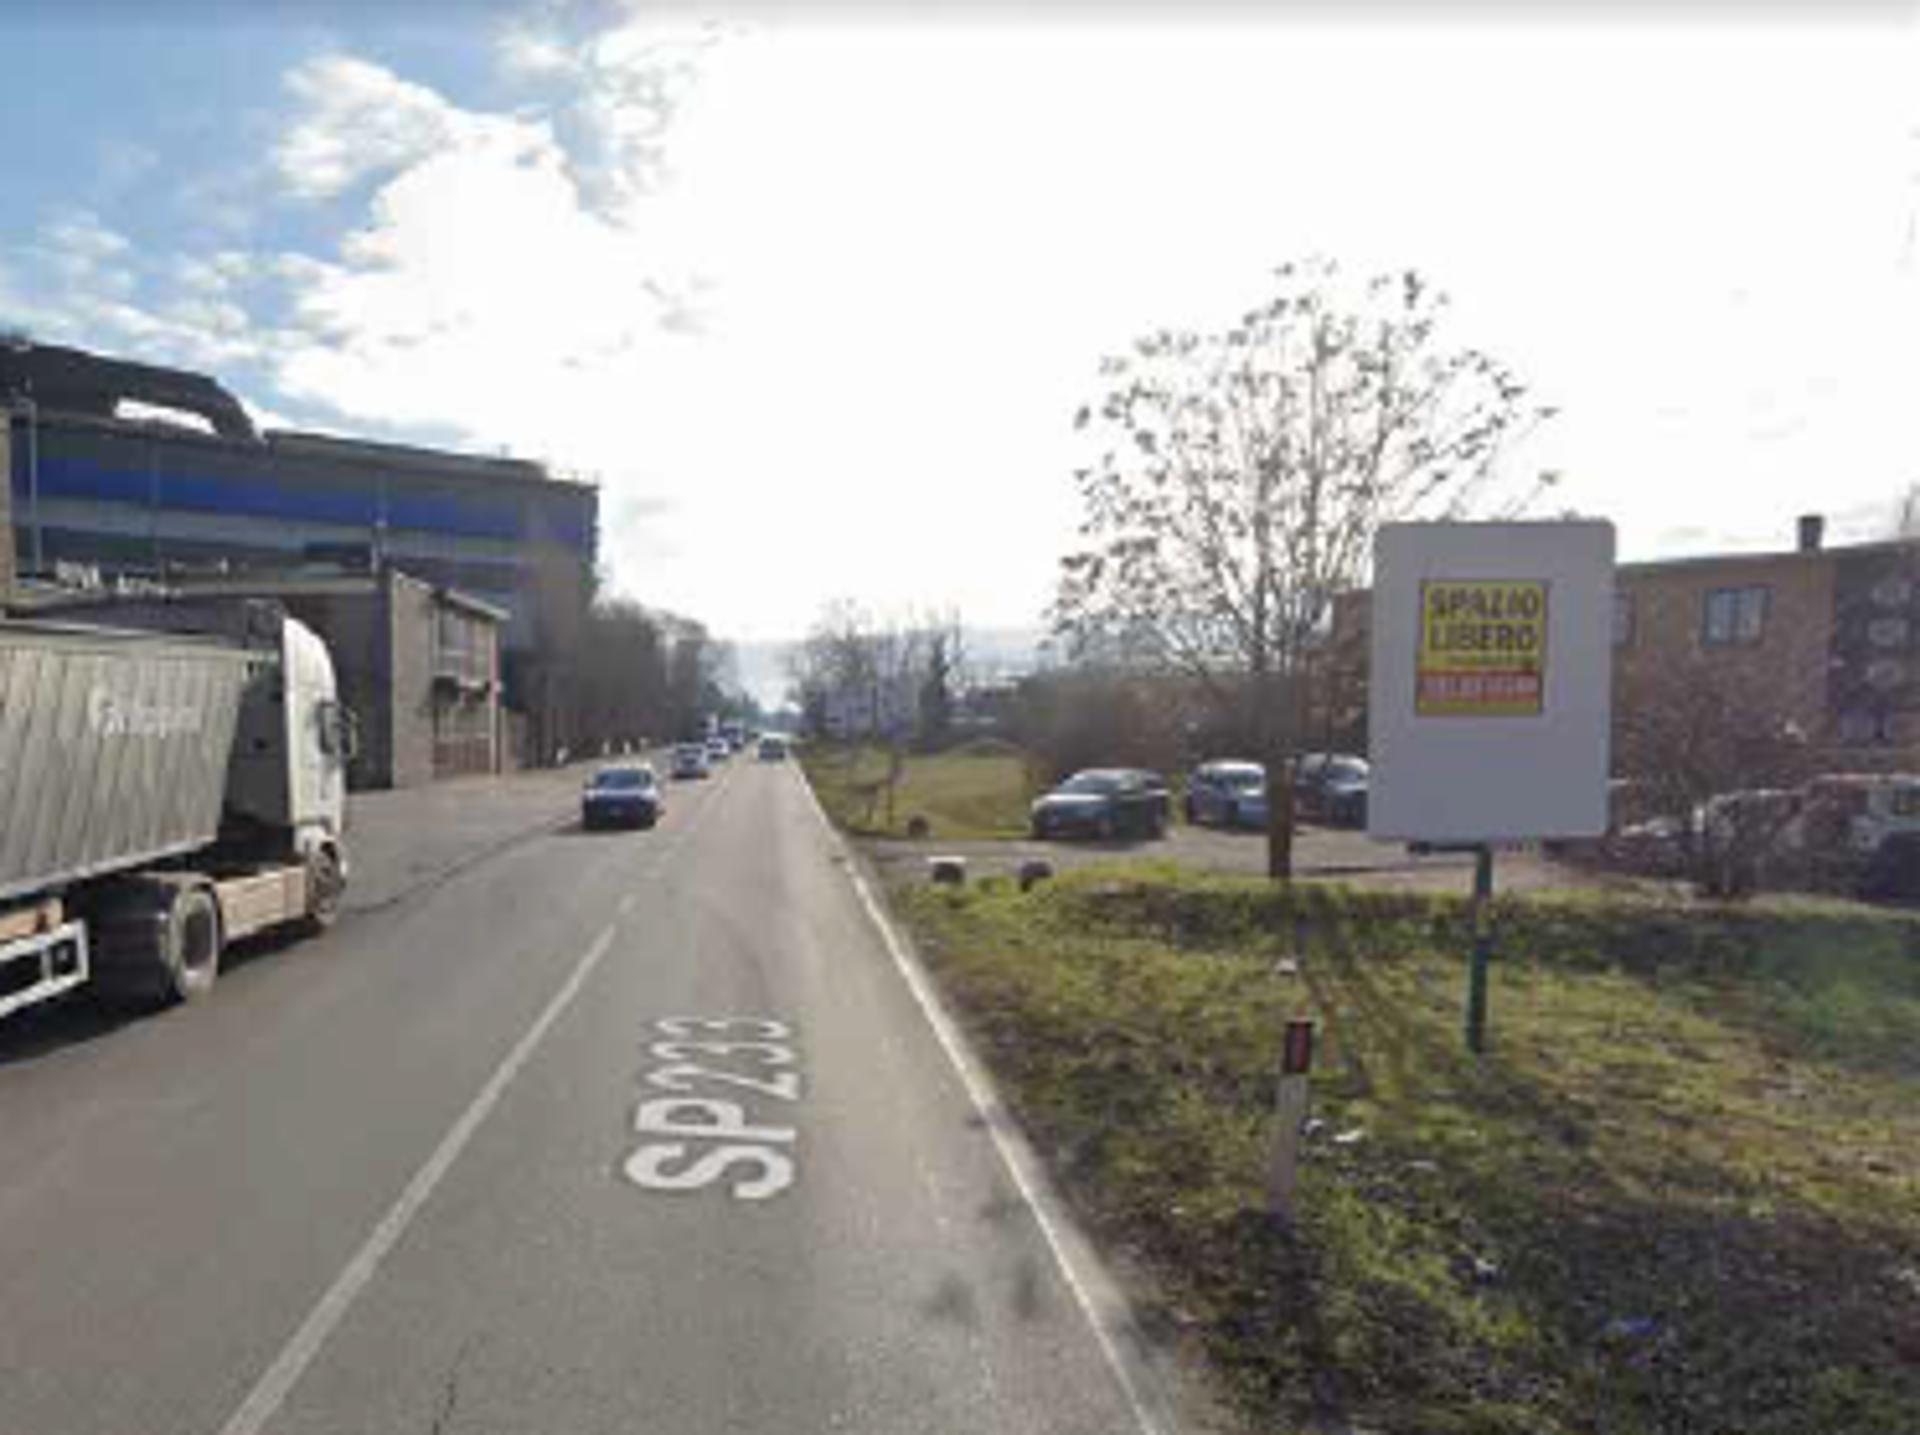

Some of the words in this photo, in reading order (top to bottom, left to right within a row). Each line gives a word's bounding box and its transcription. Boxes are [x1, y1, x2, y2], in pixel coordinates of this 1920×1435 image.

[1429, 587, 1539, 619] SPAZIO
[1429, 622, 1538, 651] LIBERO
[624, 1016, 800, 1200] SP233
